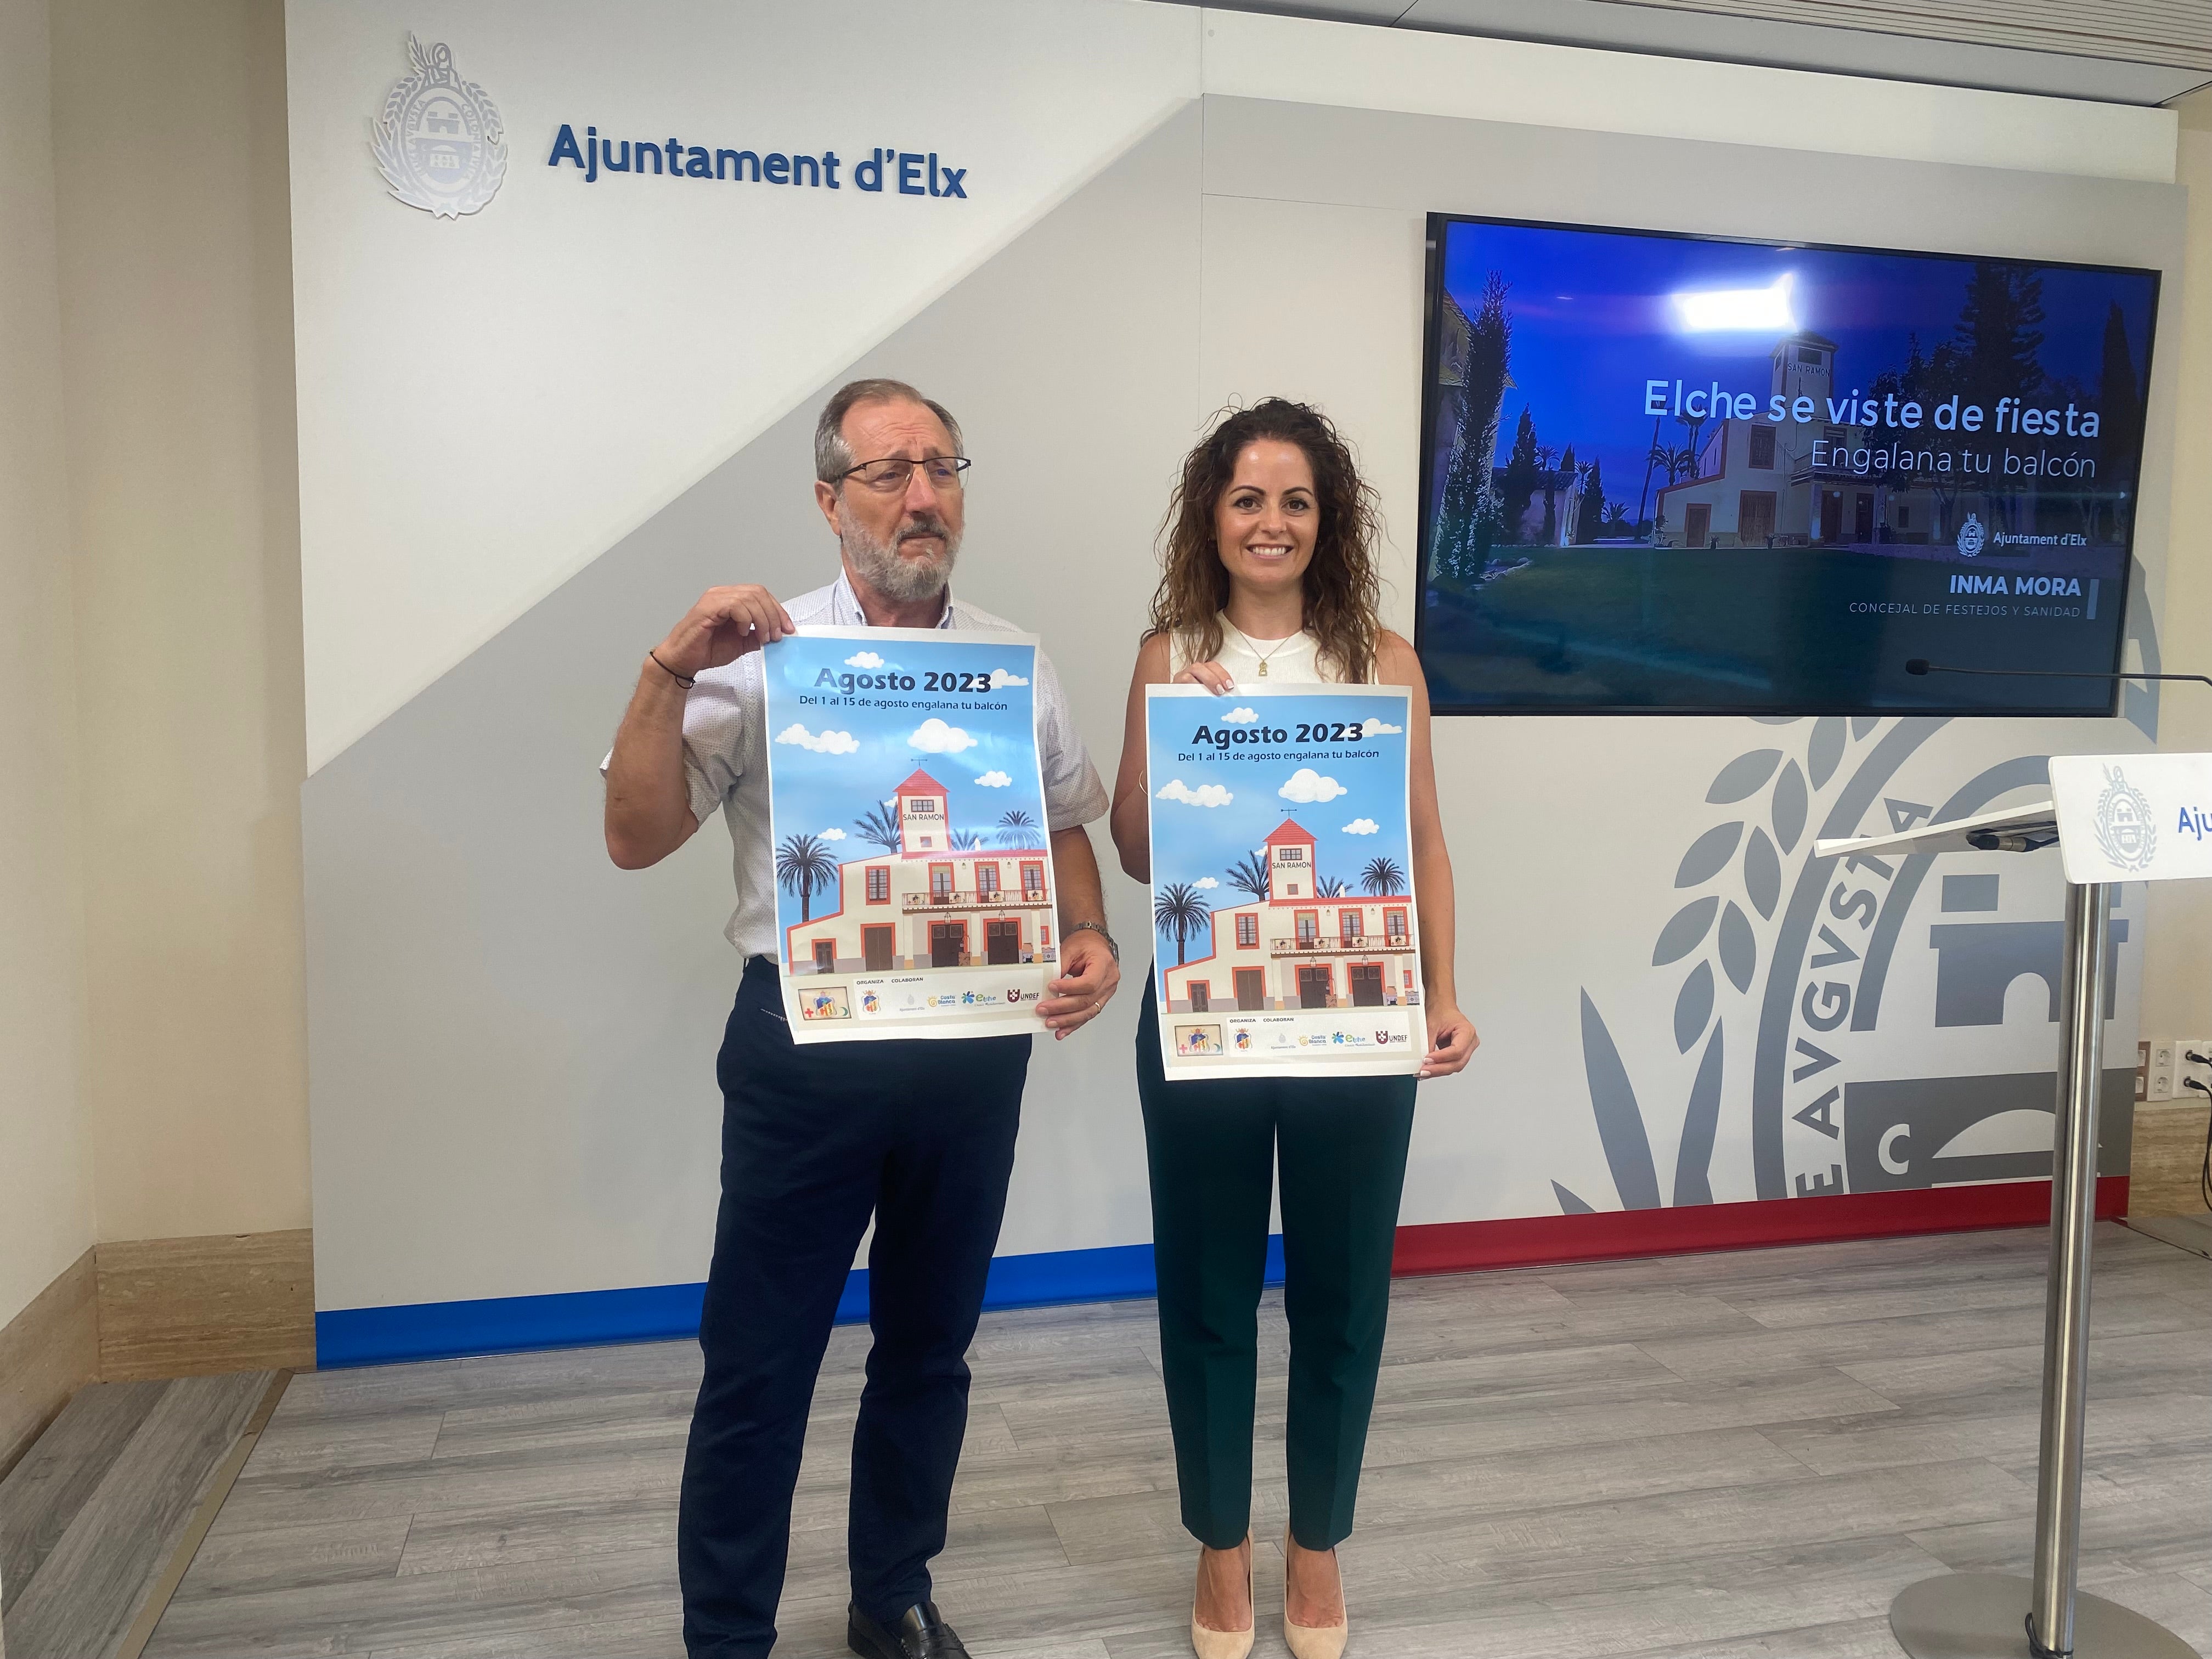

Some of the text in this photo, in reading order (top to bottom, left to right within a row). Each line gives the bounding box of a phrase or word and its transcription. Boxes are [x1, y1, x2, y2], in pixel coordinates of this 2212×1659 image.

[548, 124, 840, 189] Ajuntament
[855, 148, 968, 199] d'Elx
[1788, 363, 1830, 377] SAN RAMON
[1644, 380, 2100, 437] Elche se viste de fiesta
[1810, 439, 2096, 478] Engalana tu balcón
[1993, 532, 2087, 546] Ajuntament d'Elx
[1950, 575, 2082, 596] INMA MORA
[1849, 602, 2080, 617] CONCEJAL DE FESTEJOS Y SANIDAD
[814, 668, 991, 695] Agosto 2023
[800, 695, 817, 705] Del
[822, 697, 826, 705] 1
[830, 697, 839, 706] al
[843, 697, 855, 706] 15
[858, 697, 871, 707] de
[874, 698, 909, 709] agosto
[911, 700, 958, 710] engalana
[974, 701, 1008, 711] balcón
[1192, 723, 1363, 750] Agosto 2023
[1178, 752, 1194, 761] Del
[1198, 752, 1202, 760] 1
[1206, 752, 1215, 761] al
[1218, 752, 1230, 760] 15
[1233, 752, 1245, 760] de
[1248, 752, 1281, 762] agosto
[1284, 751, 1329, 761] engalana
[1345, 749, 1380, 758] balcón
[1877, 1123, 1911, 1175] C
